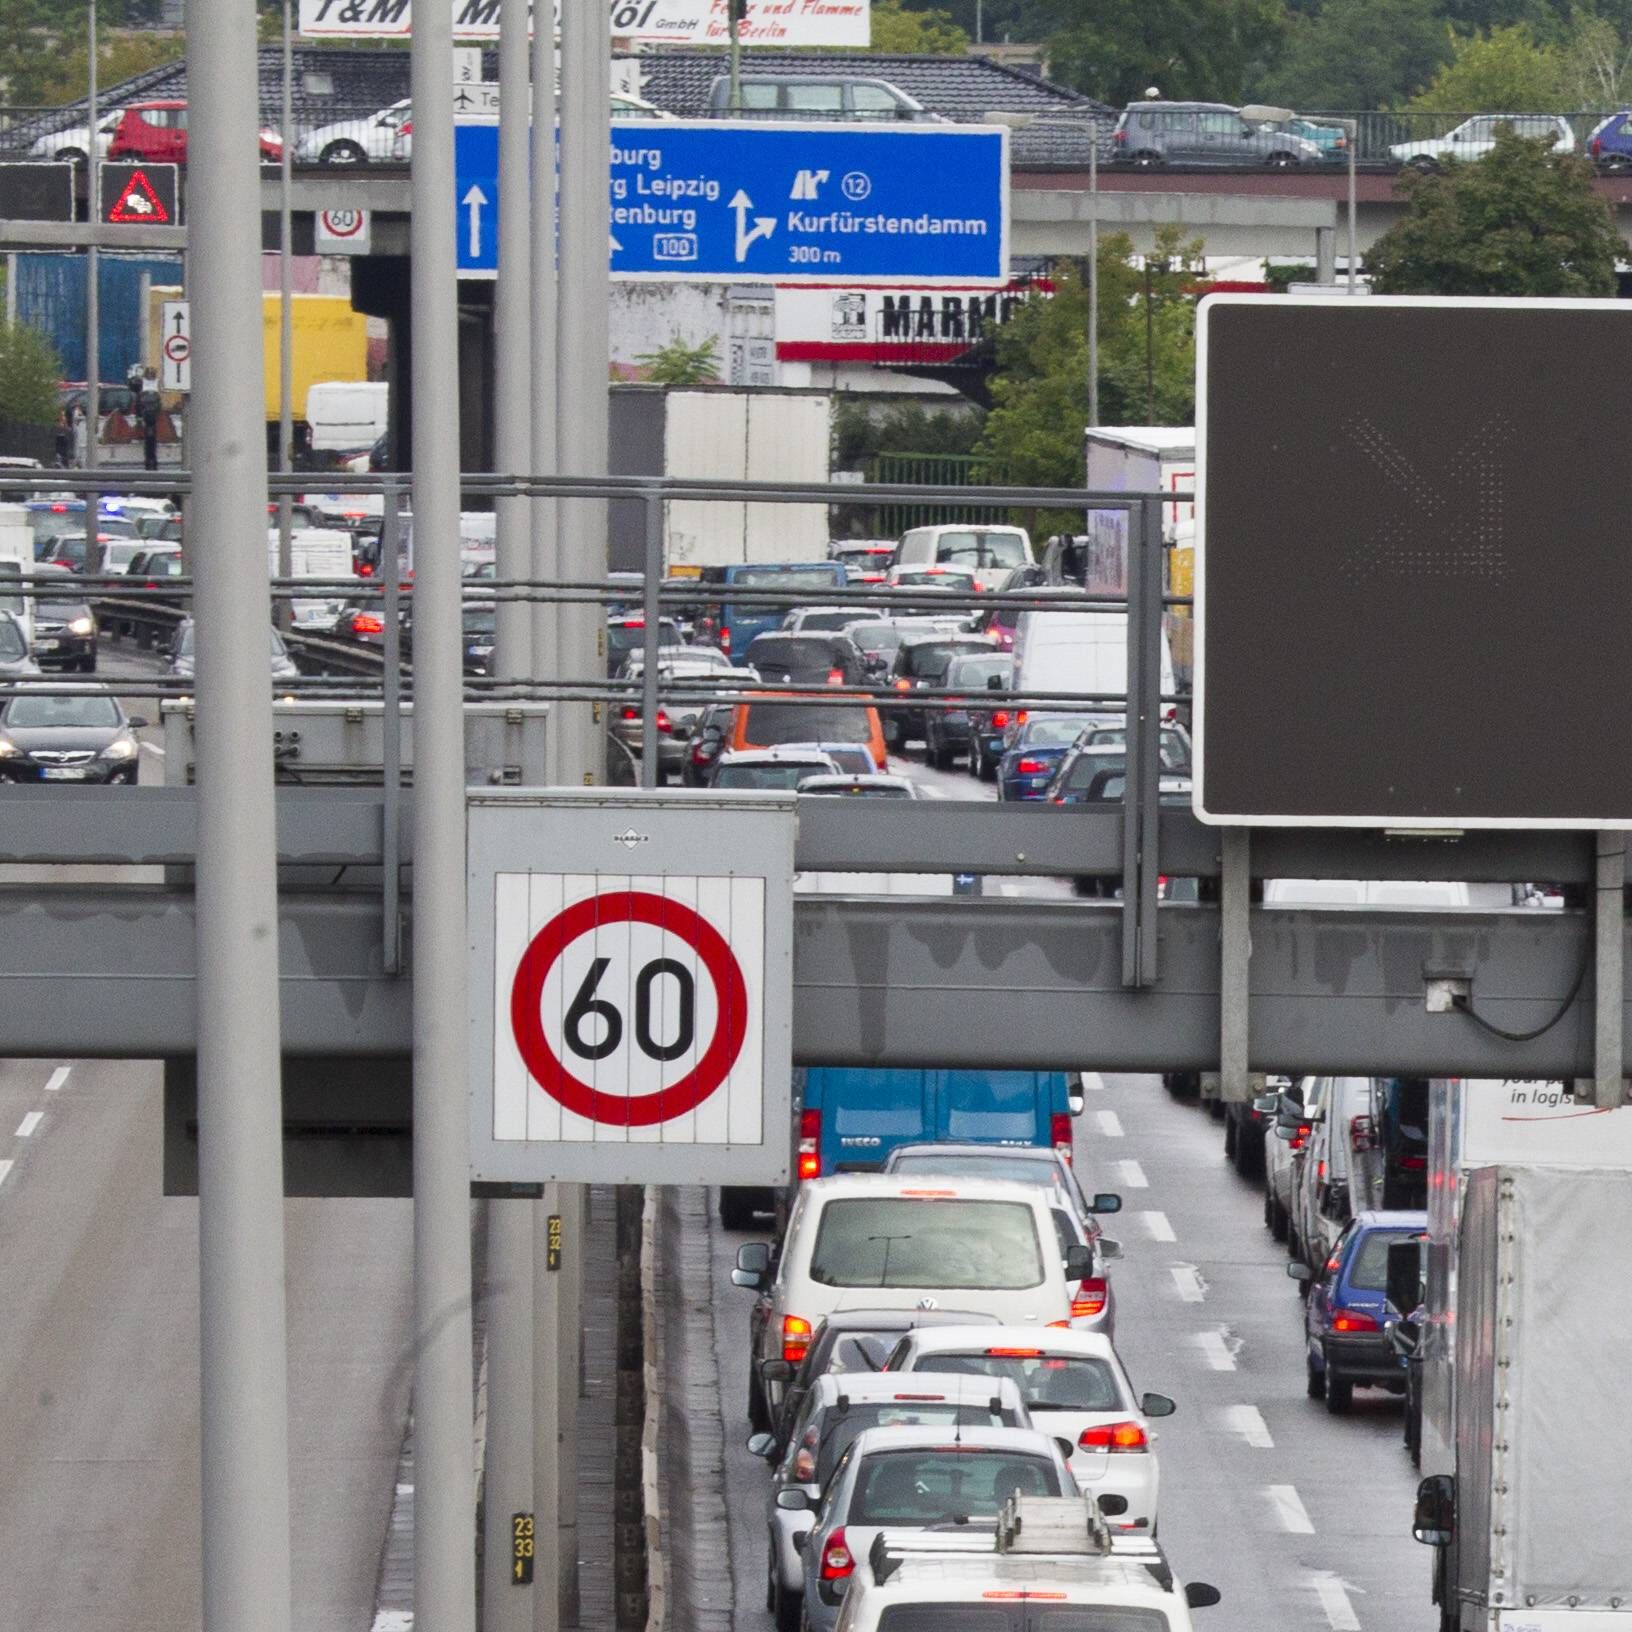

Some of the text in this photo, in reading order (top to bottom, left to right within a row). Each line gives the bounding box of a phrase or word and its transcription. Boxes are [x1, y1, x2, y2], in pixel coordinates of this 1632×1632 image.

[655, 19, 701, 30] GmbH
[736, 19, 788, 38] Berlin
[637, 174, 720, 200] Leipzig
[846, 177, 863, 194] 12
[787, 211, 988, 235] Kurfürstendamm
[661, 238, 691, 256] 100
[789, 246, 841, 263] 300 m
[564, 957, 695, 1062] 60
[1511, 1088, 1526, 1104] in
[515, 1517, 534, 1537] 23
[515, 1538, 534, 1557] 33
